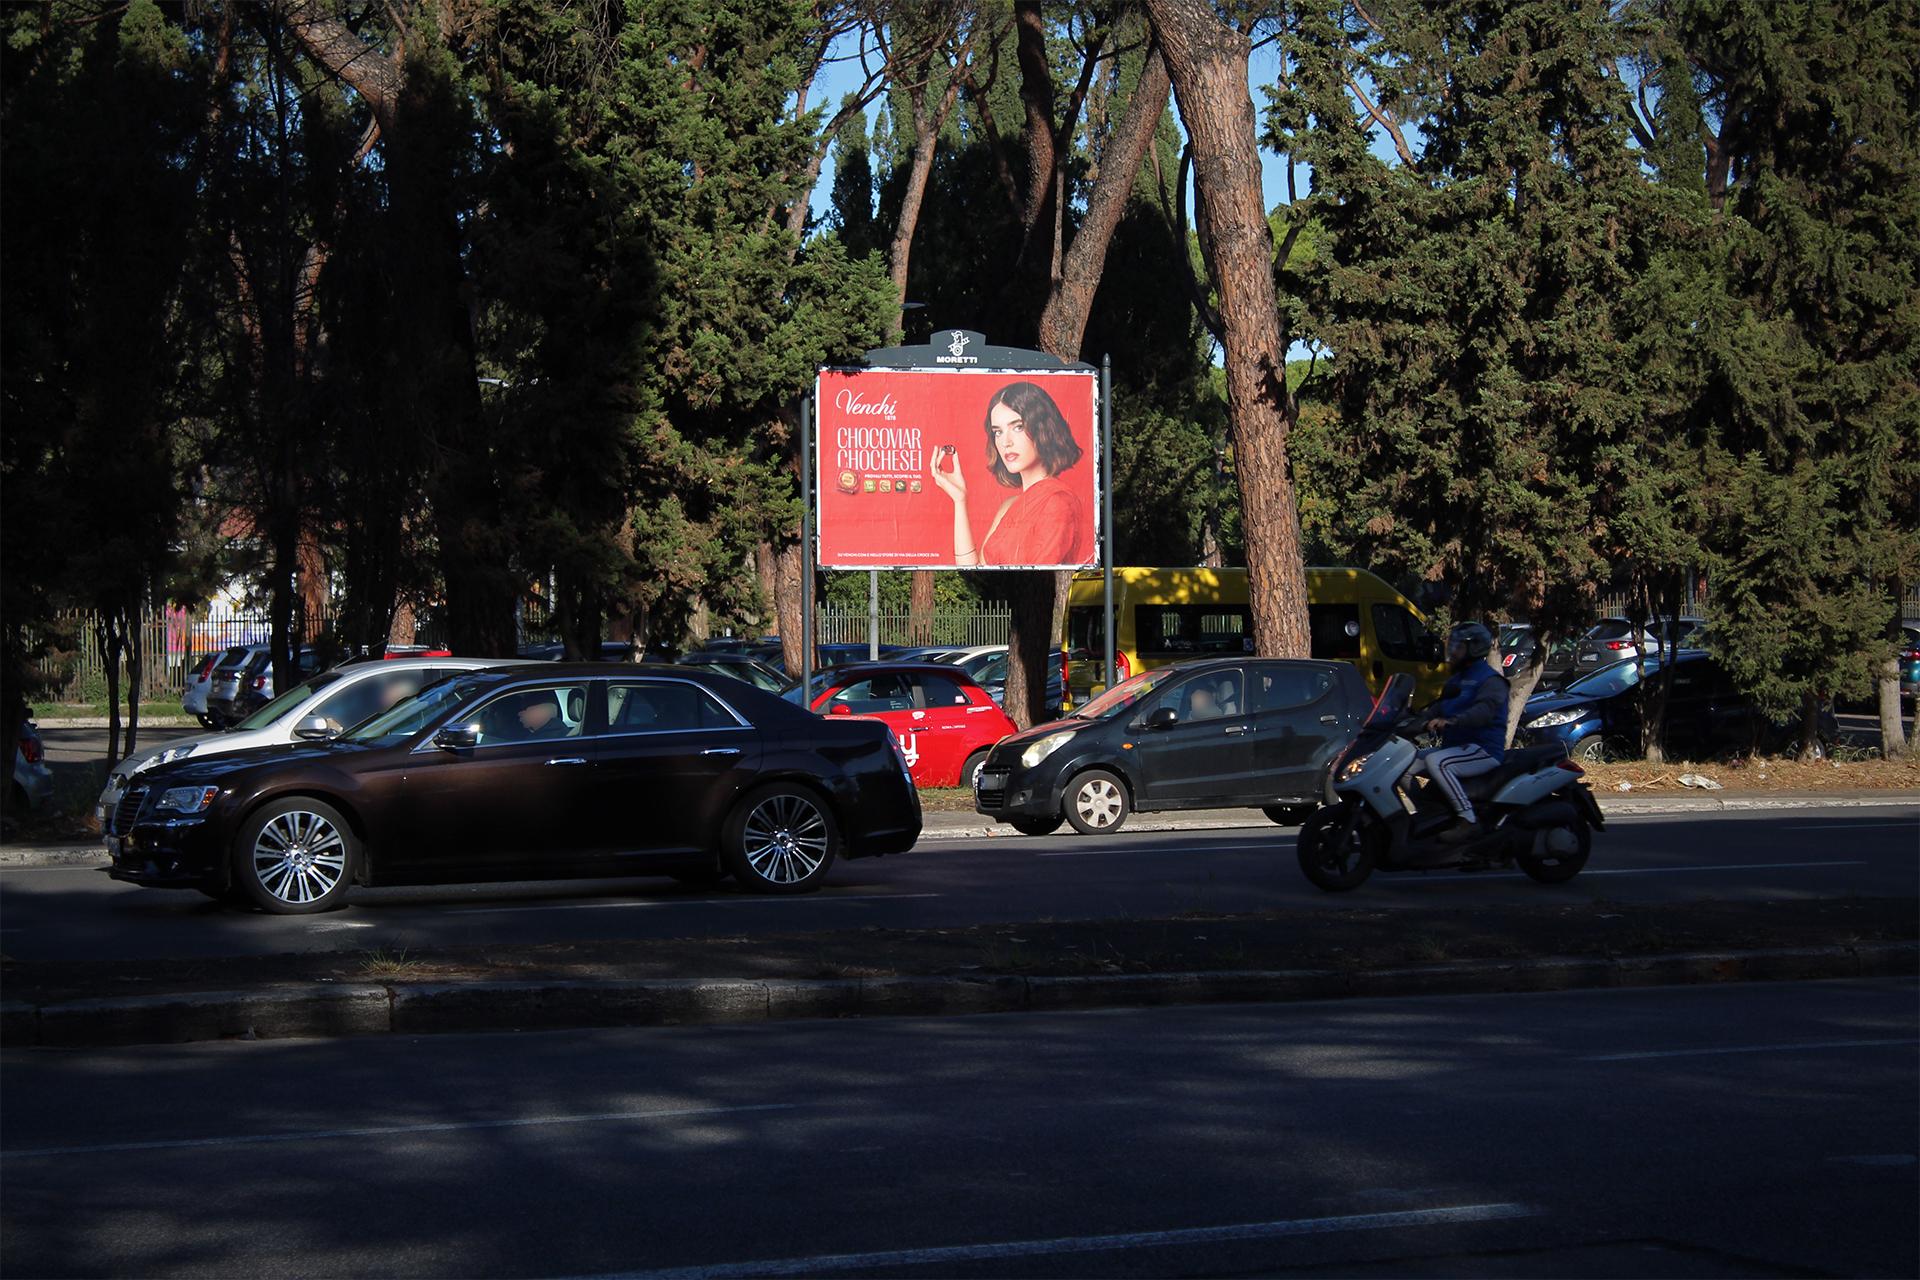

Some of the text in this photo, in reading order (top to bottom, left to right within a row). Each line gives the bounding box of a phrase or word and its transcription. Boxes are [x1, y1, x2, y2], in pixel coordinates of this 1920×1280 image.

[936, 356, 978, 364] MORETTI
[836, 389, 898, 415] Venchi
[837, 427, 922, 449] CHOCOVIAR
